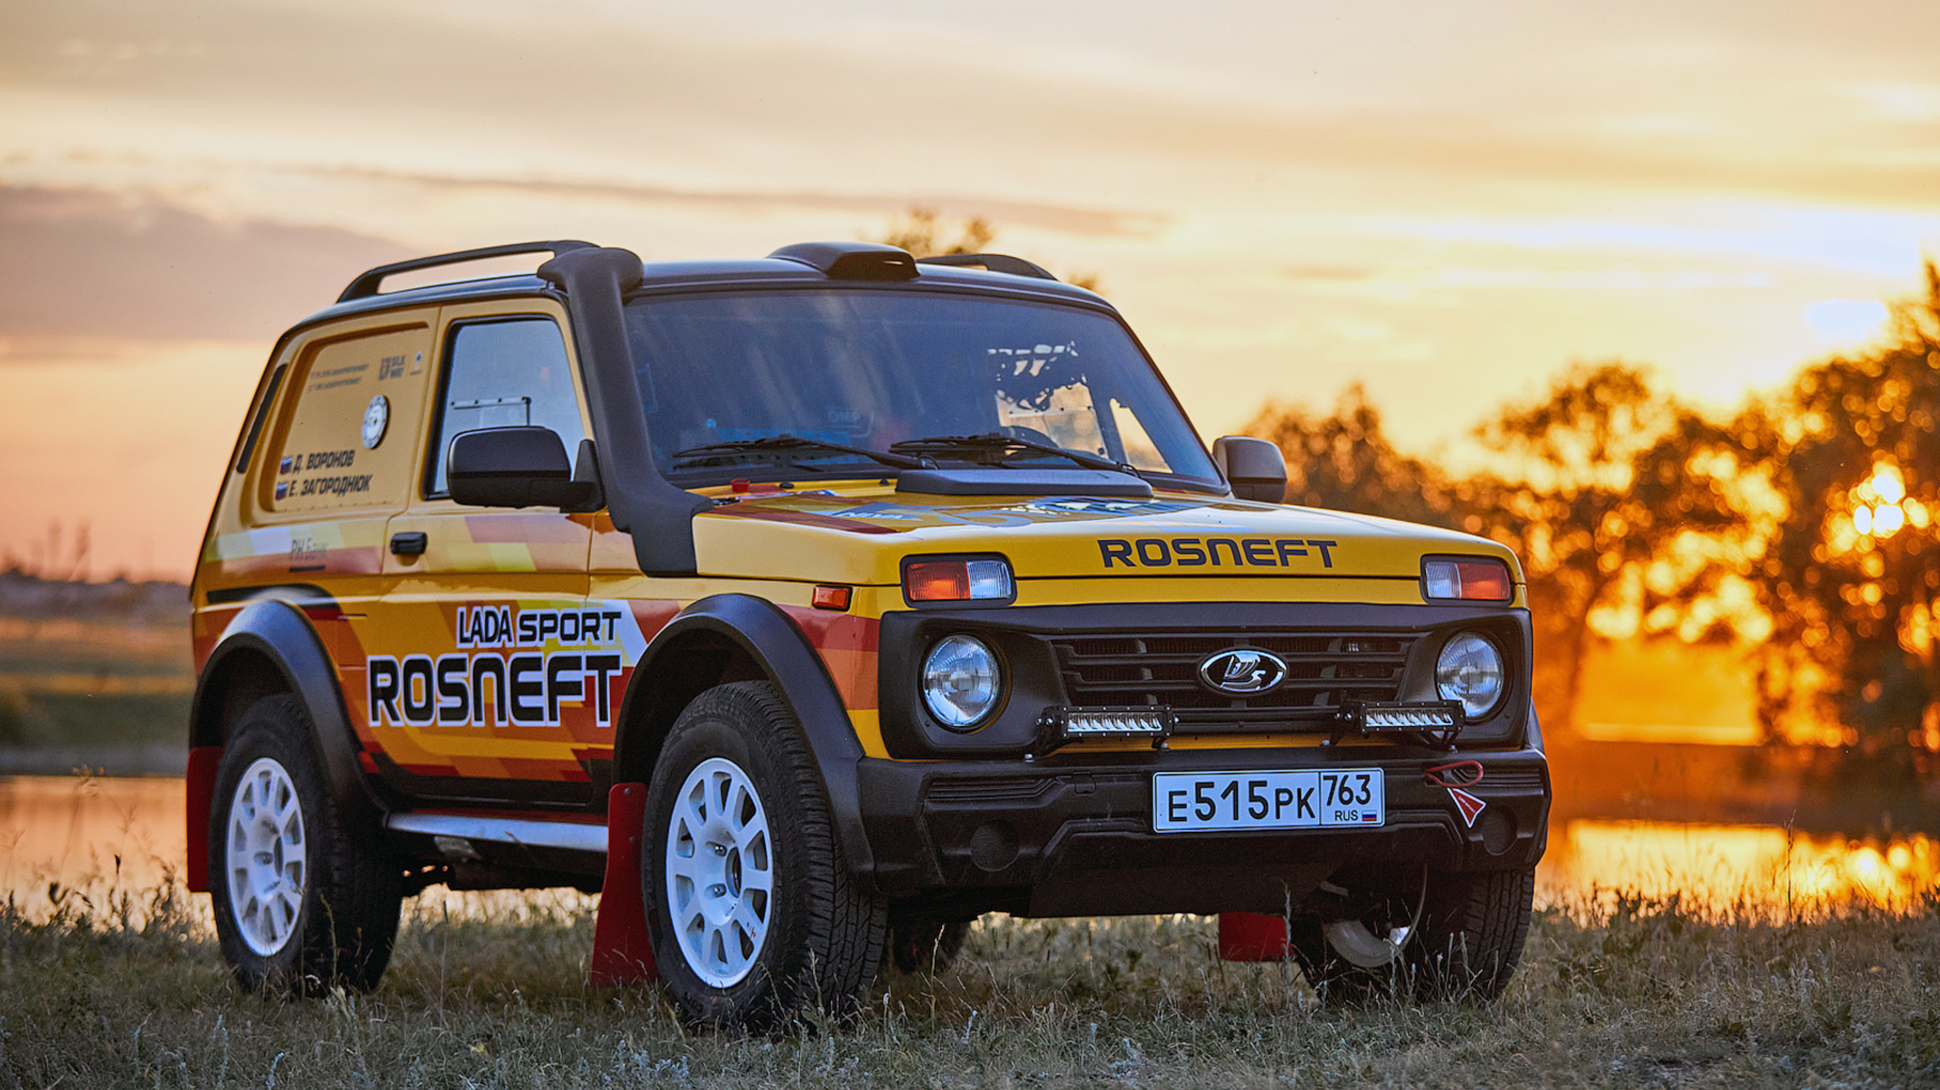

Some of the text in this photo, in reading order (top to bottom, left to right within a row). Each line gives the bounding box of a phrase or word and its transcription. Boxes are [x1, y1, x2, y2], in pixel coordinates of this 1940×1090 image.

[306, 449, 355, 471] ВОРОНОВ
[300, 474, 374, 497] ЗАГОРОДНЮК
[1097, 538, 1338, 568] ROSNEFT
[457, 606, 622, 647] LADA SPORT
[367, 652, 622, 727] ROSNEFT
[1323, 774, 1372, 806] 763
[1334, 810, 1359, 821] RUS
